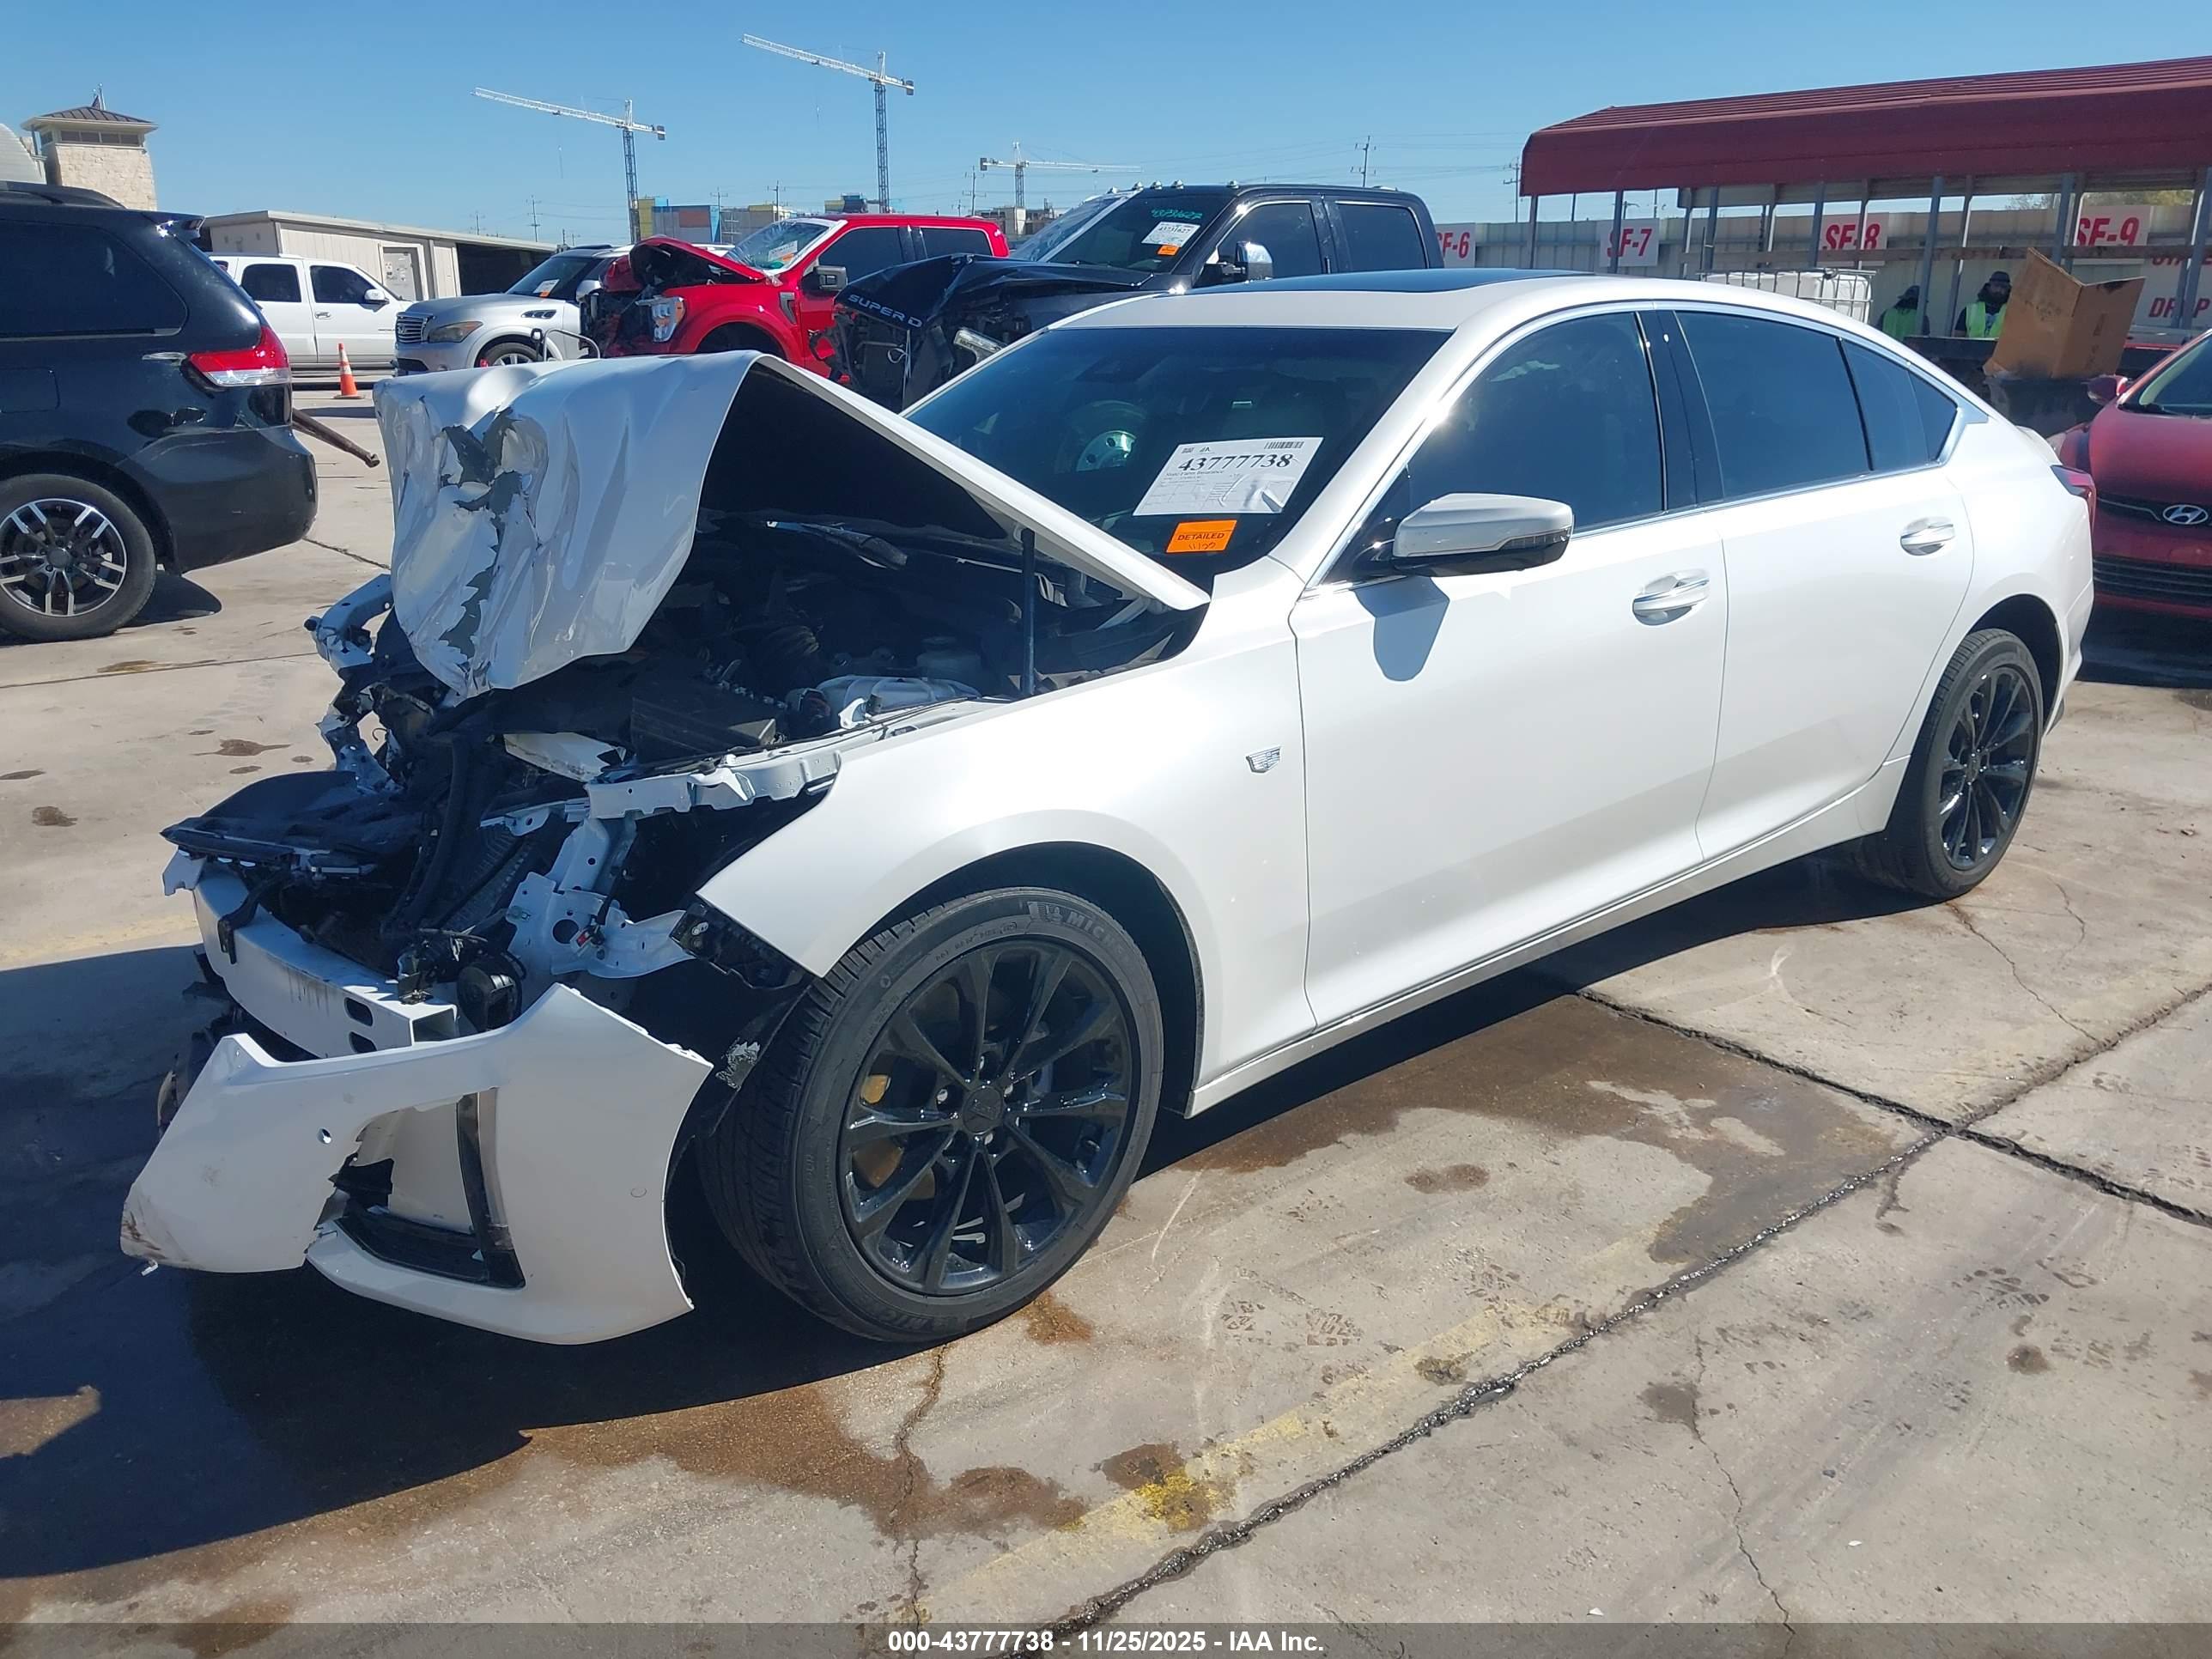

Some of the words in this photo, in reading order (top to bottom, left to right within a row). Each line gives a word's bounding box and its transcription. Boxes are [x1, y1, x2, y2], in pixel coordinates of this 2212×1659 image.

[2077, 217, 2139, 246] SF-9
[848, 294, 906, 322] SUPER
[1177, 453, 1293, 471] 43777738
[1177, 532, 1225, 541] DETAILED
